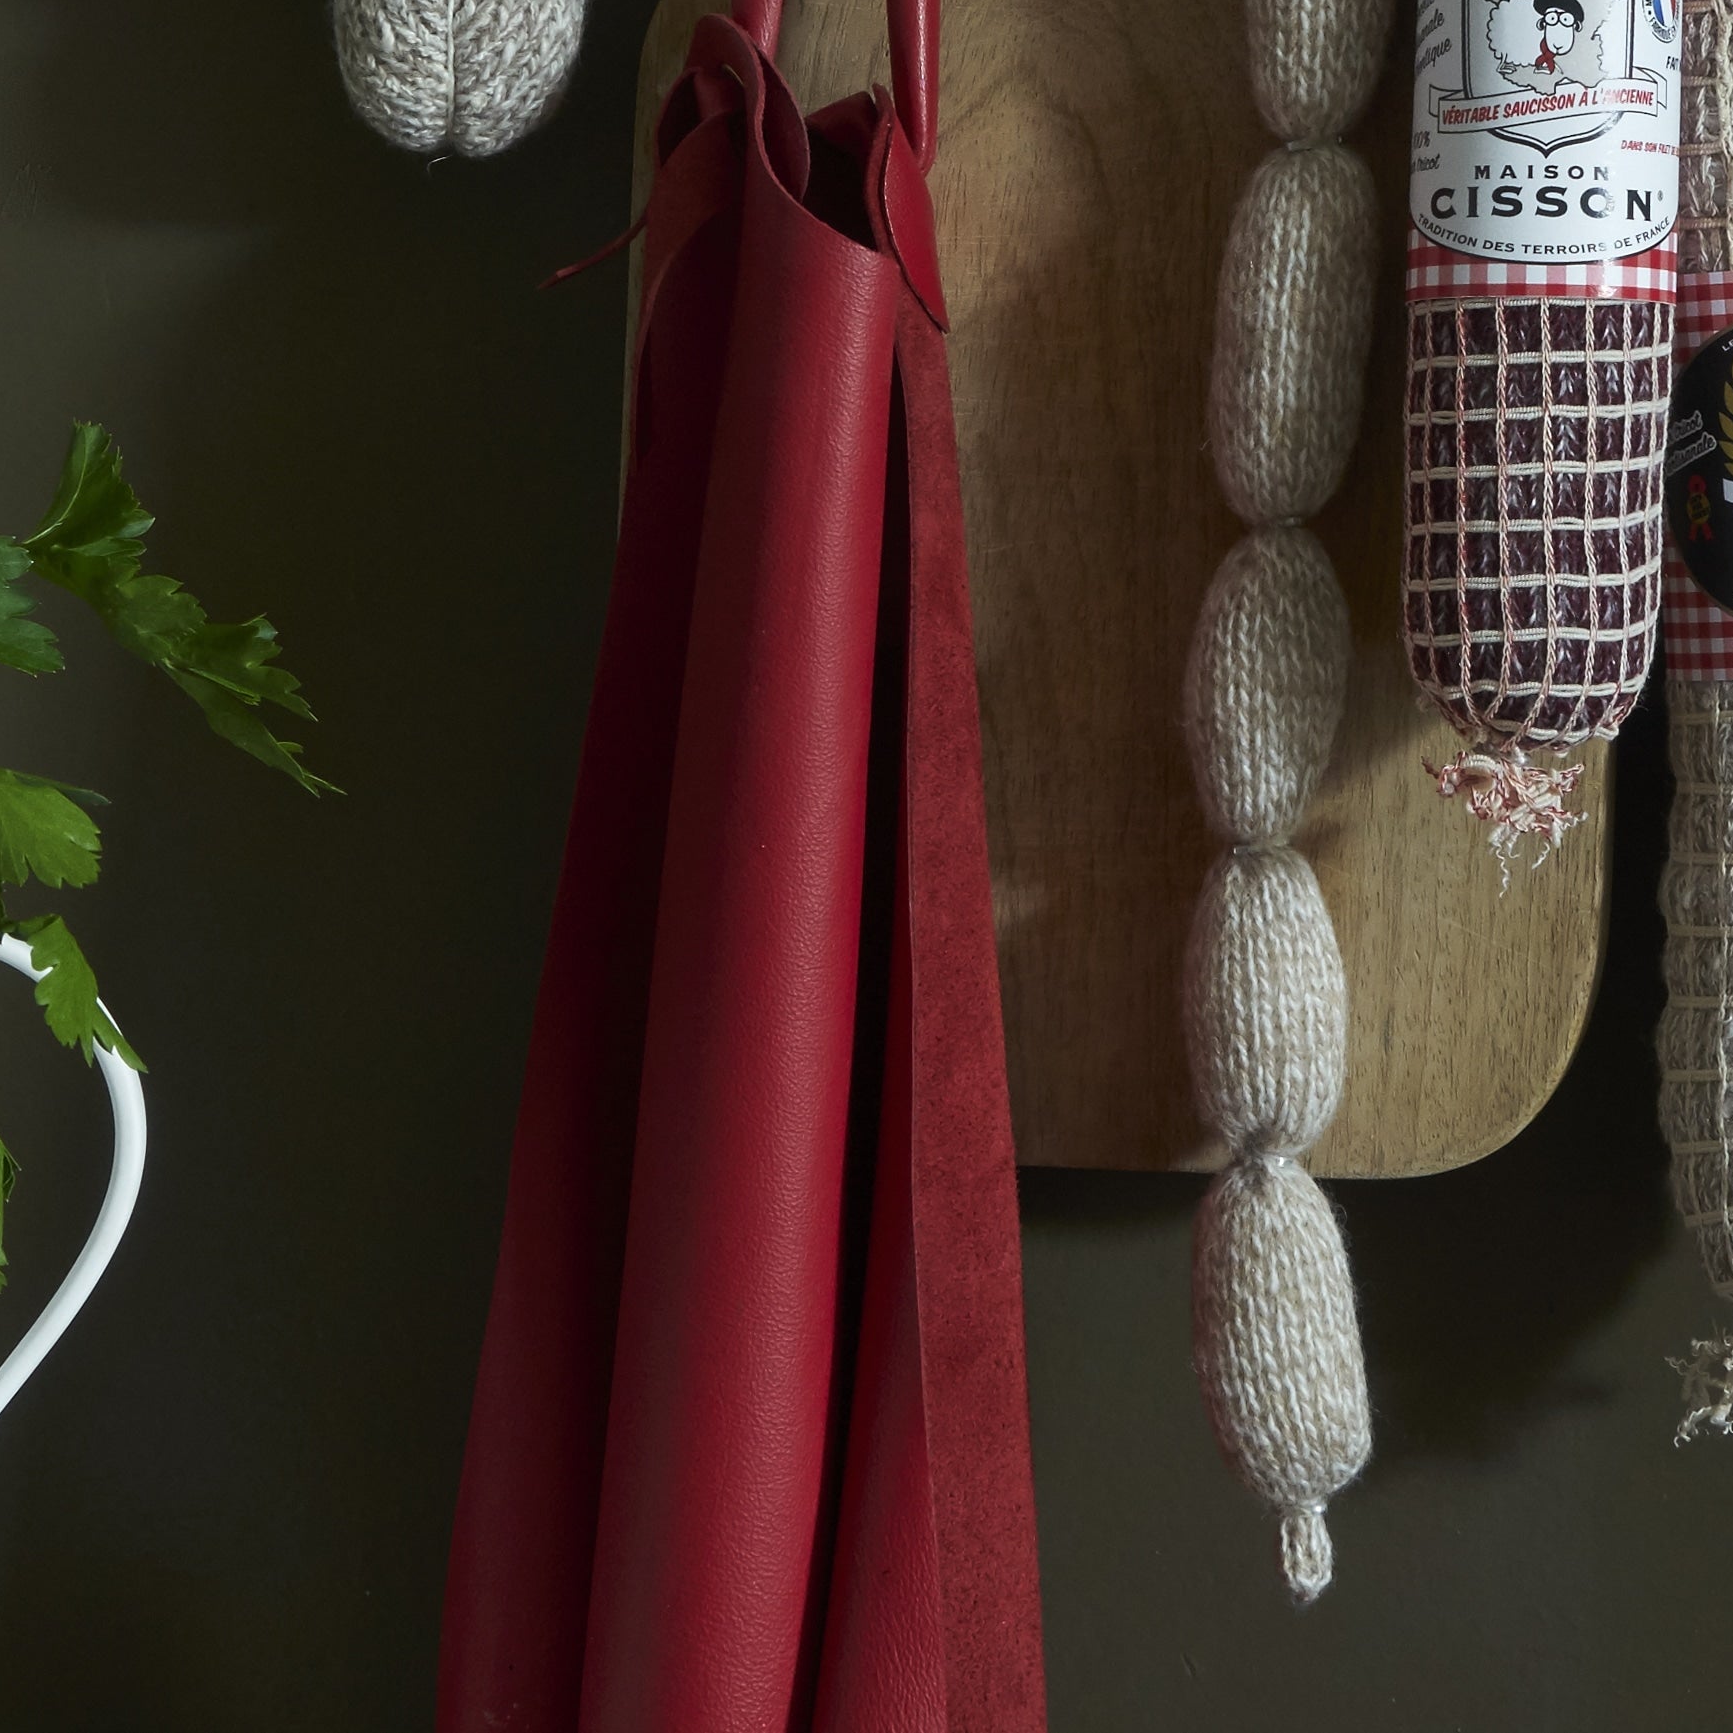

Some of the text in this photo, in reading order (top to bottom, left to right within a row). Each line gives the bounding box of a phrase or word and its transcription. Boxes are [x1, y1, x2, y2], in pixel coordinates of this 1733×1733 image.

[1442, 105, 1499, 125] VÉRITABLE
[1503, 93, 1576, 118] SAUCISSON
[1592, 88, 1654, 106] L'ANCIENNE
[1474, 165, 1610, 181] MAISON
[1417, 214, 1671, 255] TRADITION DES TERROIRS DE FRANCE
